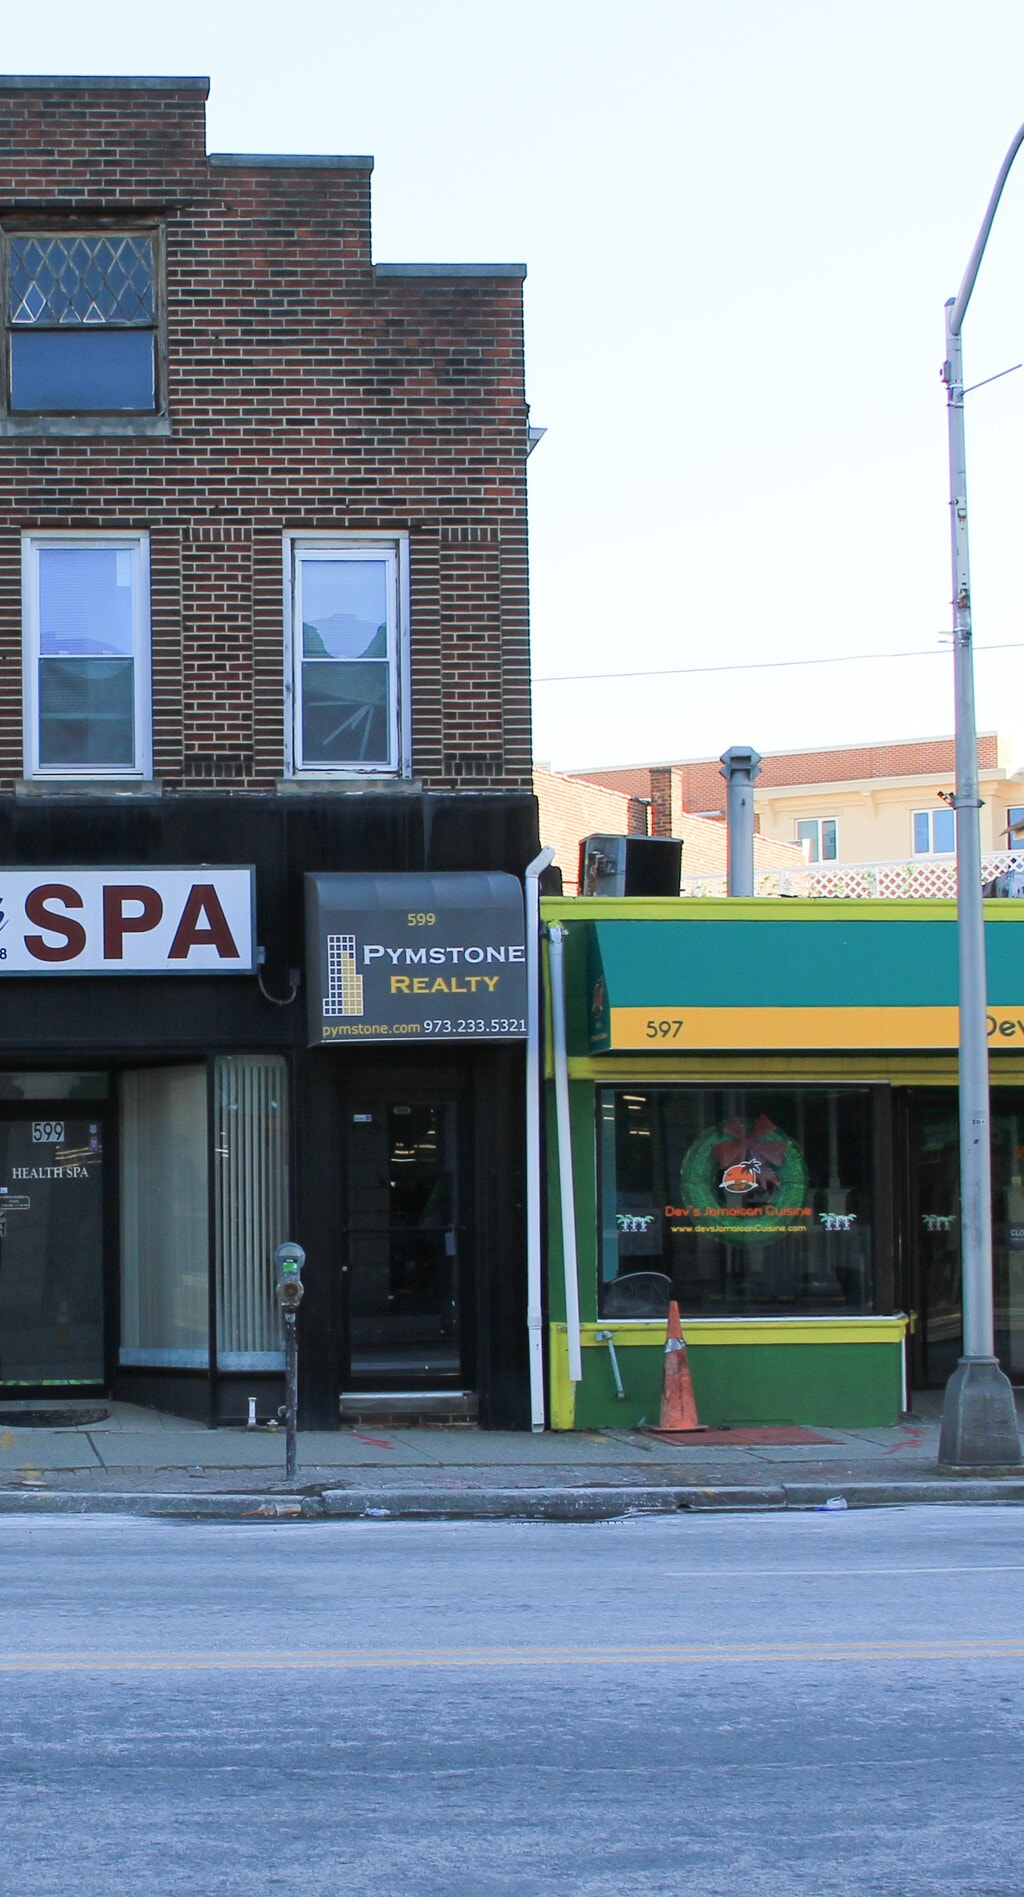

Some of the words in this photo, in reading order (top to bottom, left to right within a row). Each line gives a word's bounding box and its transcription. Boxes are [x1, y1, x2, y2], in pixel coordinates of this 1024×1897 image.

[23, 883, 241, 962] SPA
[407, 912, 436, 926] 599
[322, 1021, 421, 1037] pymstone.com
[423, 1019, 527, 1033] 973.233.5321
[646, 1020, 684, 1039] 597
[33, 1122, 63, 1141] 599
[12, 1167, 63, 1179] HEALTH
[66, 1166, 89, 1178] SPA
[665, 1205, 701, 1217] Dev's
[704, 1206, 763, 1217] Jamaican
[765, 1205, 812, 1216] Cuisine
